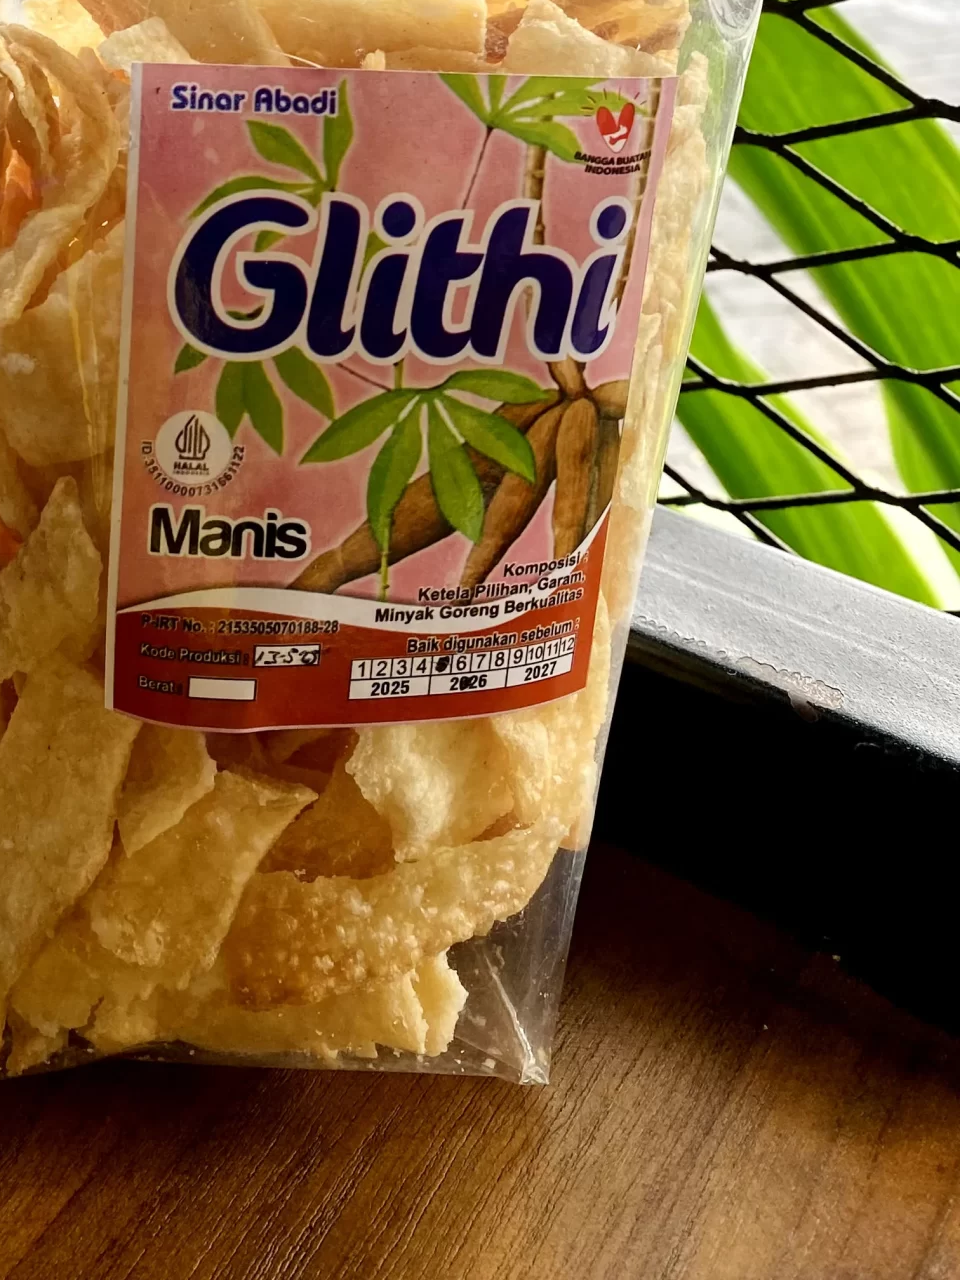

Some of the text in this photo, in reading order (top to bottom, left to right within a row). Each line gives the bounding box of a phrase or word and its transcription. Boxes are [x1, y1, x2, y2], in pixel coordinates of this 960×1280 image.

[171, 84, 338, 115] Sinar Abadi
[574, 151, 615, 165] BANGGA
[584, 163, 640, 175] INDONESIA
[167, 189, 634, 365] Glithi
[173, 461, 209, 471] HALAL
[149, 505, 308, 559] Manis
[503, 552, 581, 577] Komposisi
[418, 587, 470, 602] Ketela
[474, 582, 533, 599] Pilihan,
[375, 588, 583, 625] Minyak Goreng Berkualitas
[217, 620, 339, 635] 2153505070188-28
[407, 637, 440, 653] Baik
[443, 631, 517, 652] digunakan
[520, 620, 573, 643] sebelum
[140, 644, 175, 659] Kode
[179, 649, 240, 664] Produksi
[358, 662, 366, 677] 1
[375, 661, 387, 676] 2
[396, 660, 407, 675] 3
[416, 658, 427, 673] 4
[456, 656, 467, 670] 6
[476, 654, 487, 669] 7
[494, 651, 505, 667] 8
[513, 649, 523, 664] 9
[528, 645, 543, 660] 10
[546, 642, 559, 656] 11
[561, 637, 575, 652] 12
[139, 676, 174, 693] Berat
[370, 681, 410, 696] 2025
[524, 662, 557, 681] 2027
